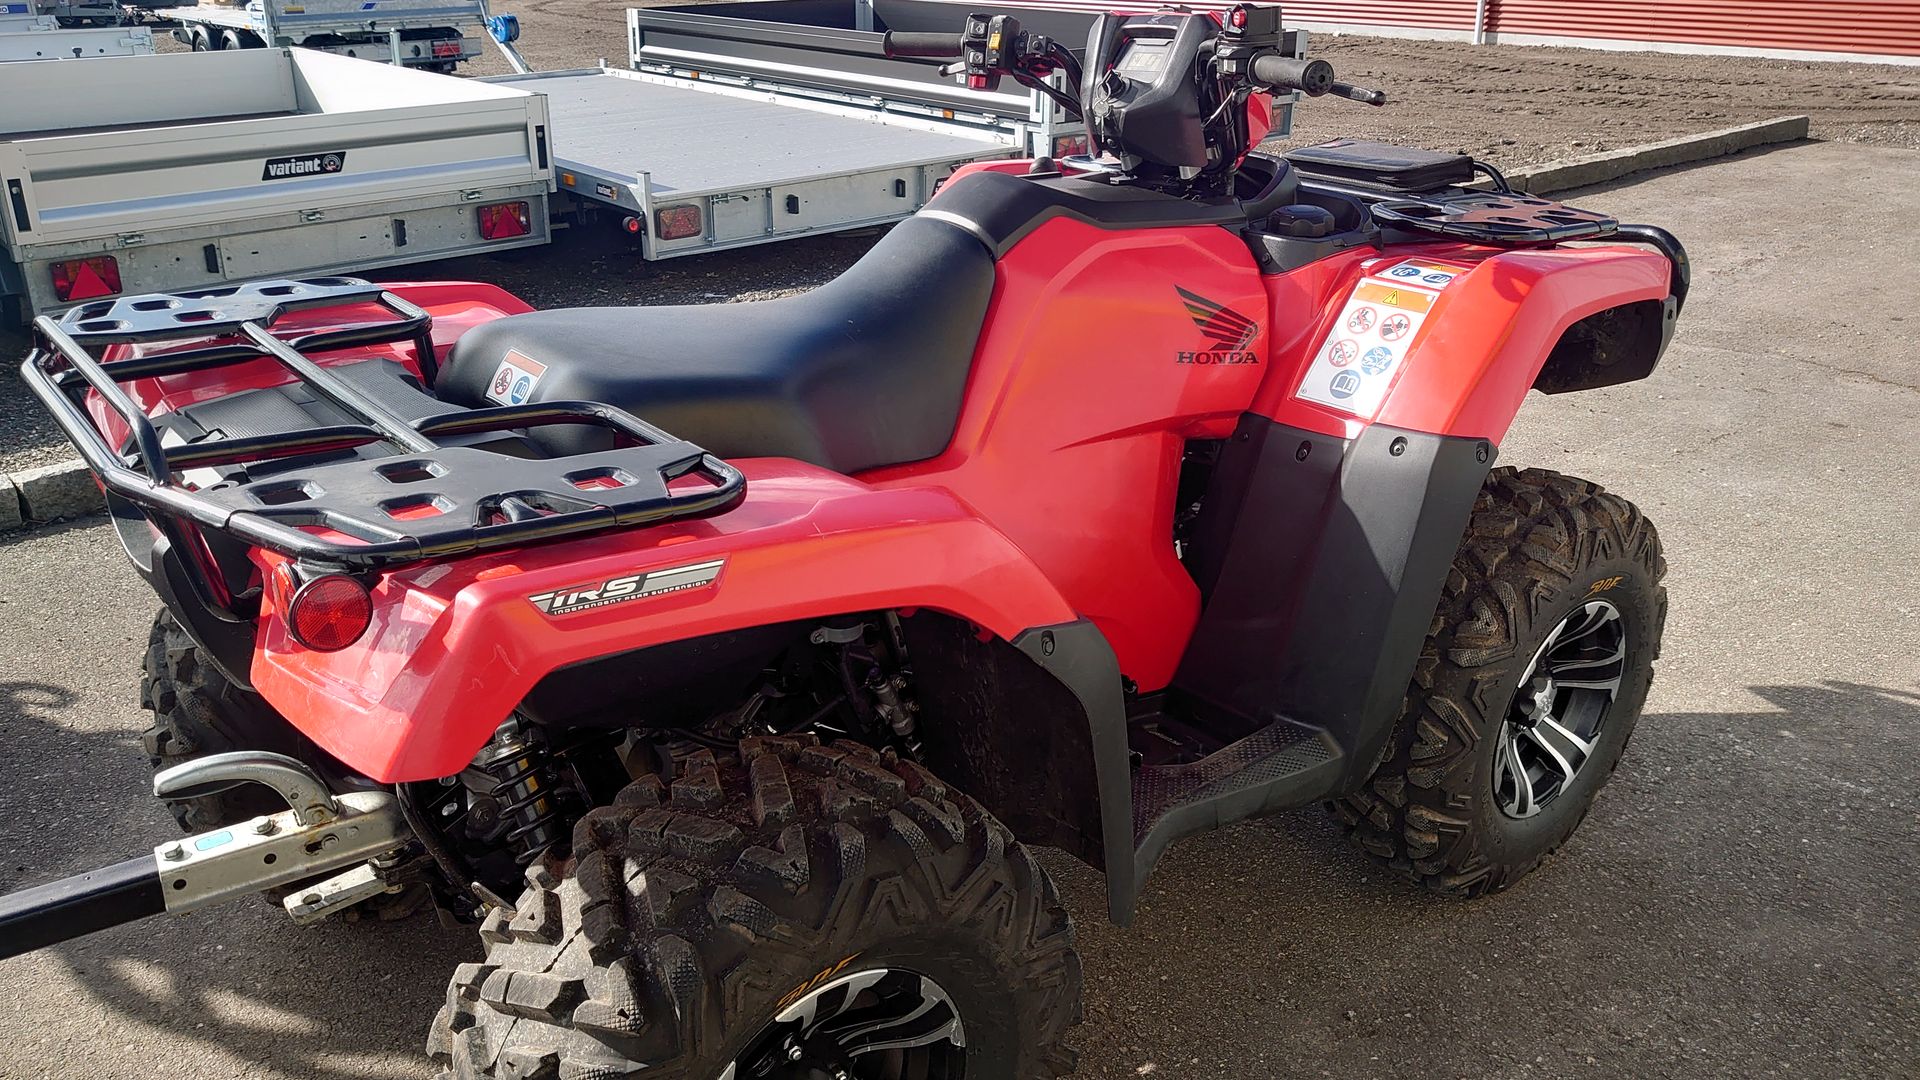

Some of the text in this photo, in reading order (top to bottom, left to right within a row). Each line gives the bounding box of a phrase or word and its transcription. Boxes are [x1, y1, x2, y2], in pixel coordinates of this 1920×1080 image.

[267, 157, 321, 177] variant
[1176, 351, 1259, 365] HONDA
[554, 580, 707, 615] INDEPENDENT REAR SUSPENSION
